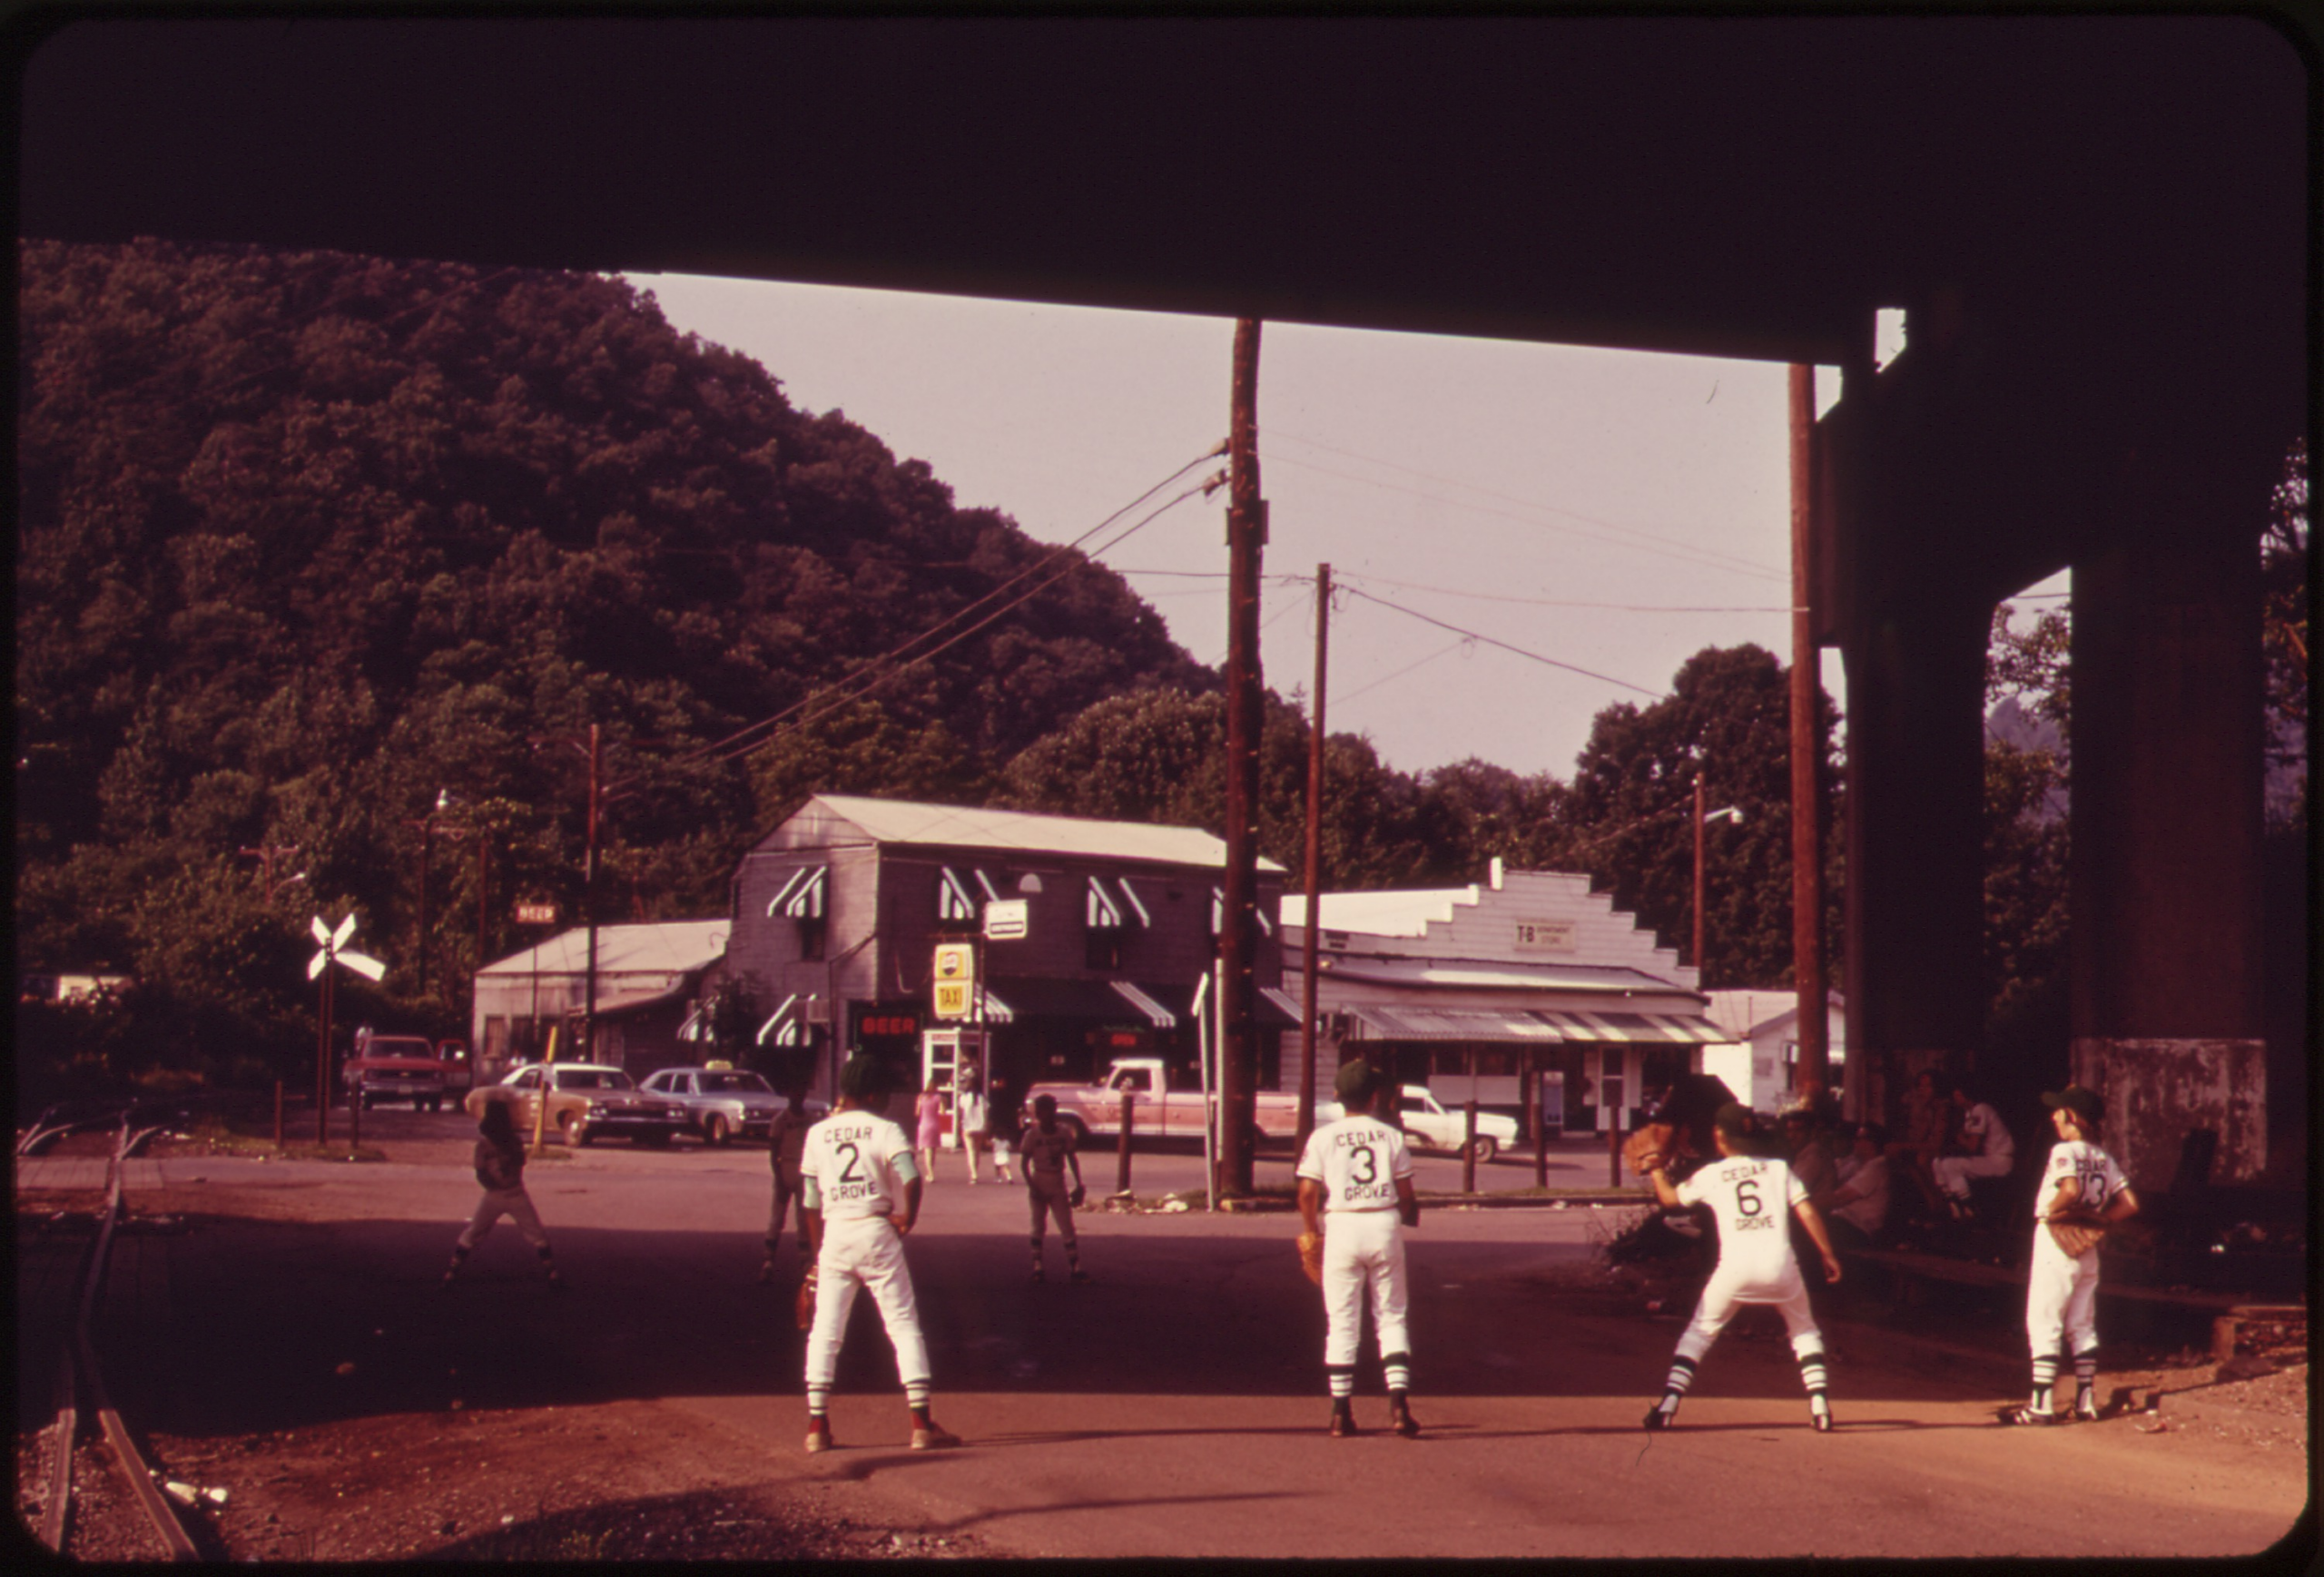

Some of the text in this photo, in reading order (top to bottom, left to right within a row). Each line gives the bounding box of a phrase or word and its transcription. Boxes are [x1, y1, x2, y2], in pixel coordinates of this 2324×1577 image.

[940, 987, 962, 1005] TAXI
[862, 1017, 915, 1034] BEER
[824, 1127, 872, 1143] CEDAR
[1335, 1130, 1385, 1147] CEDAR
[835, 1141, 864, 1183] 2
[1351, 1146, 1376, 1184] 3
[1722, 1162, 1768, 1182] CEDAR
[830, 1181, 877, 1201] GROVE
[1344, 1183, 1391, 1200] GROVE
[1736, 1179, 1762, 1217] 6
[2077, 1172, 2106, 1207] 13
[1736, 1216, 1775, 1231] GROVE
